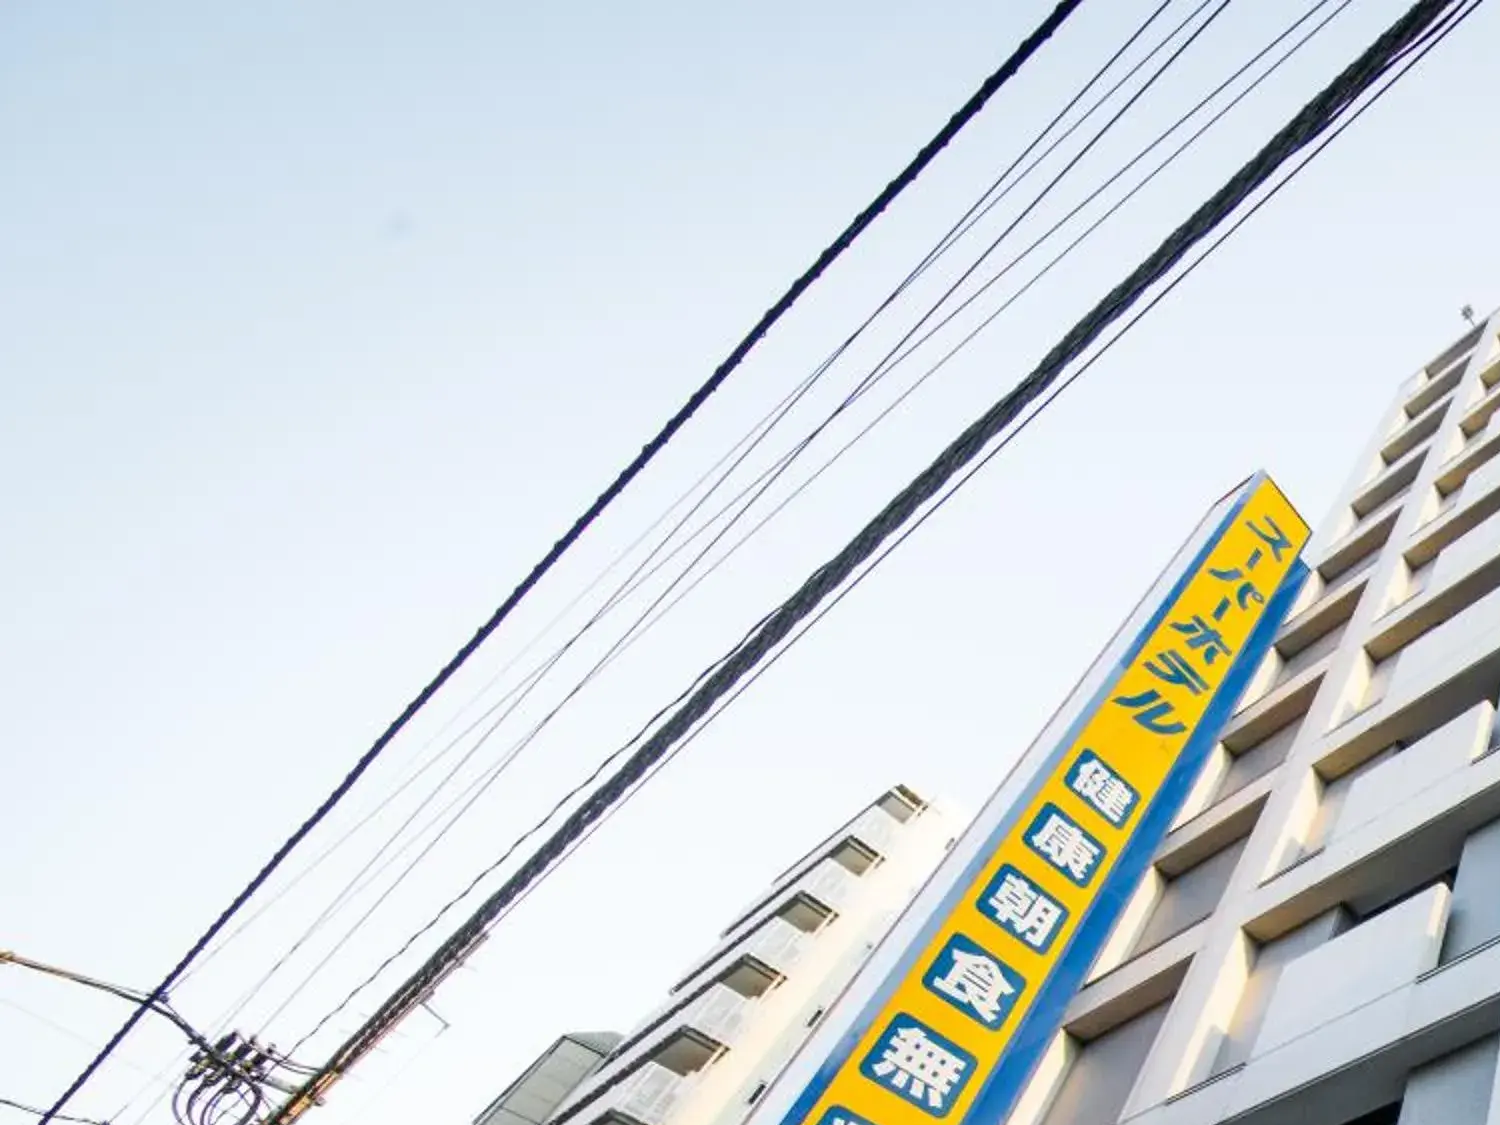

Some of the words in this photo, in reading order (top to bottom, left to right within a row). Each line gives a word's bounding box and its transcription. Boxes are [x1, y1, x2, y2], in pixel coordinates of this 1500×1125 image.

[1112, 513, 1294, 737] スーパーホテル
